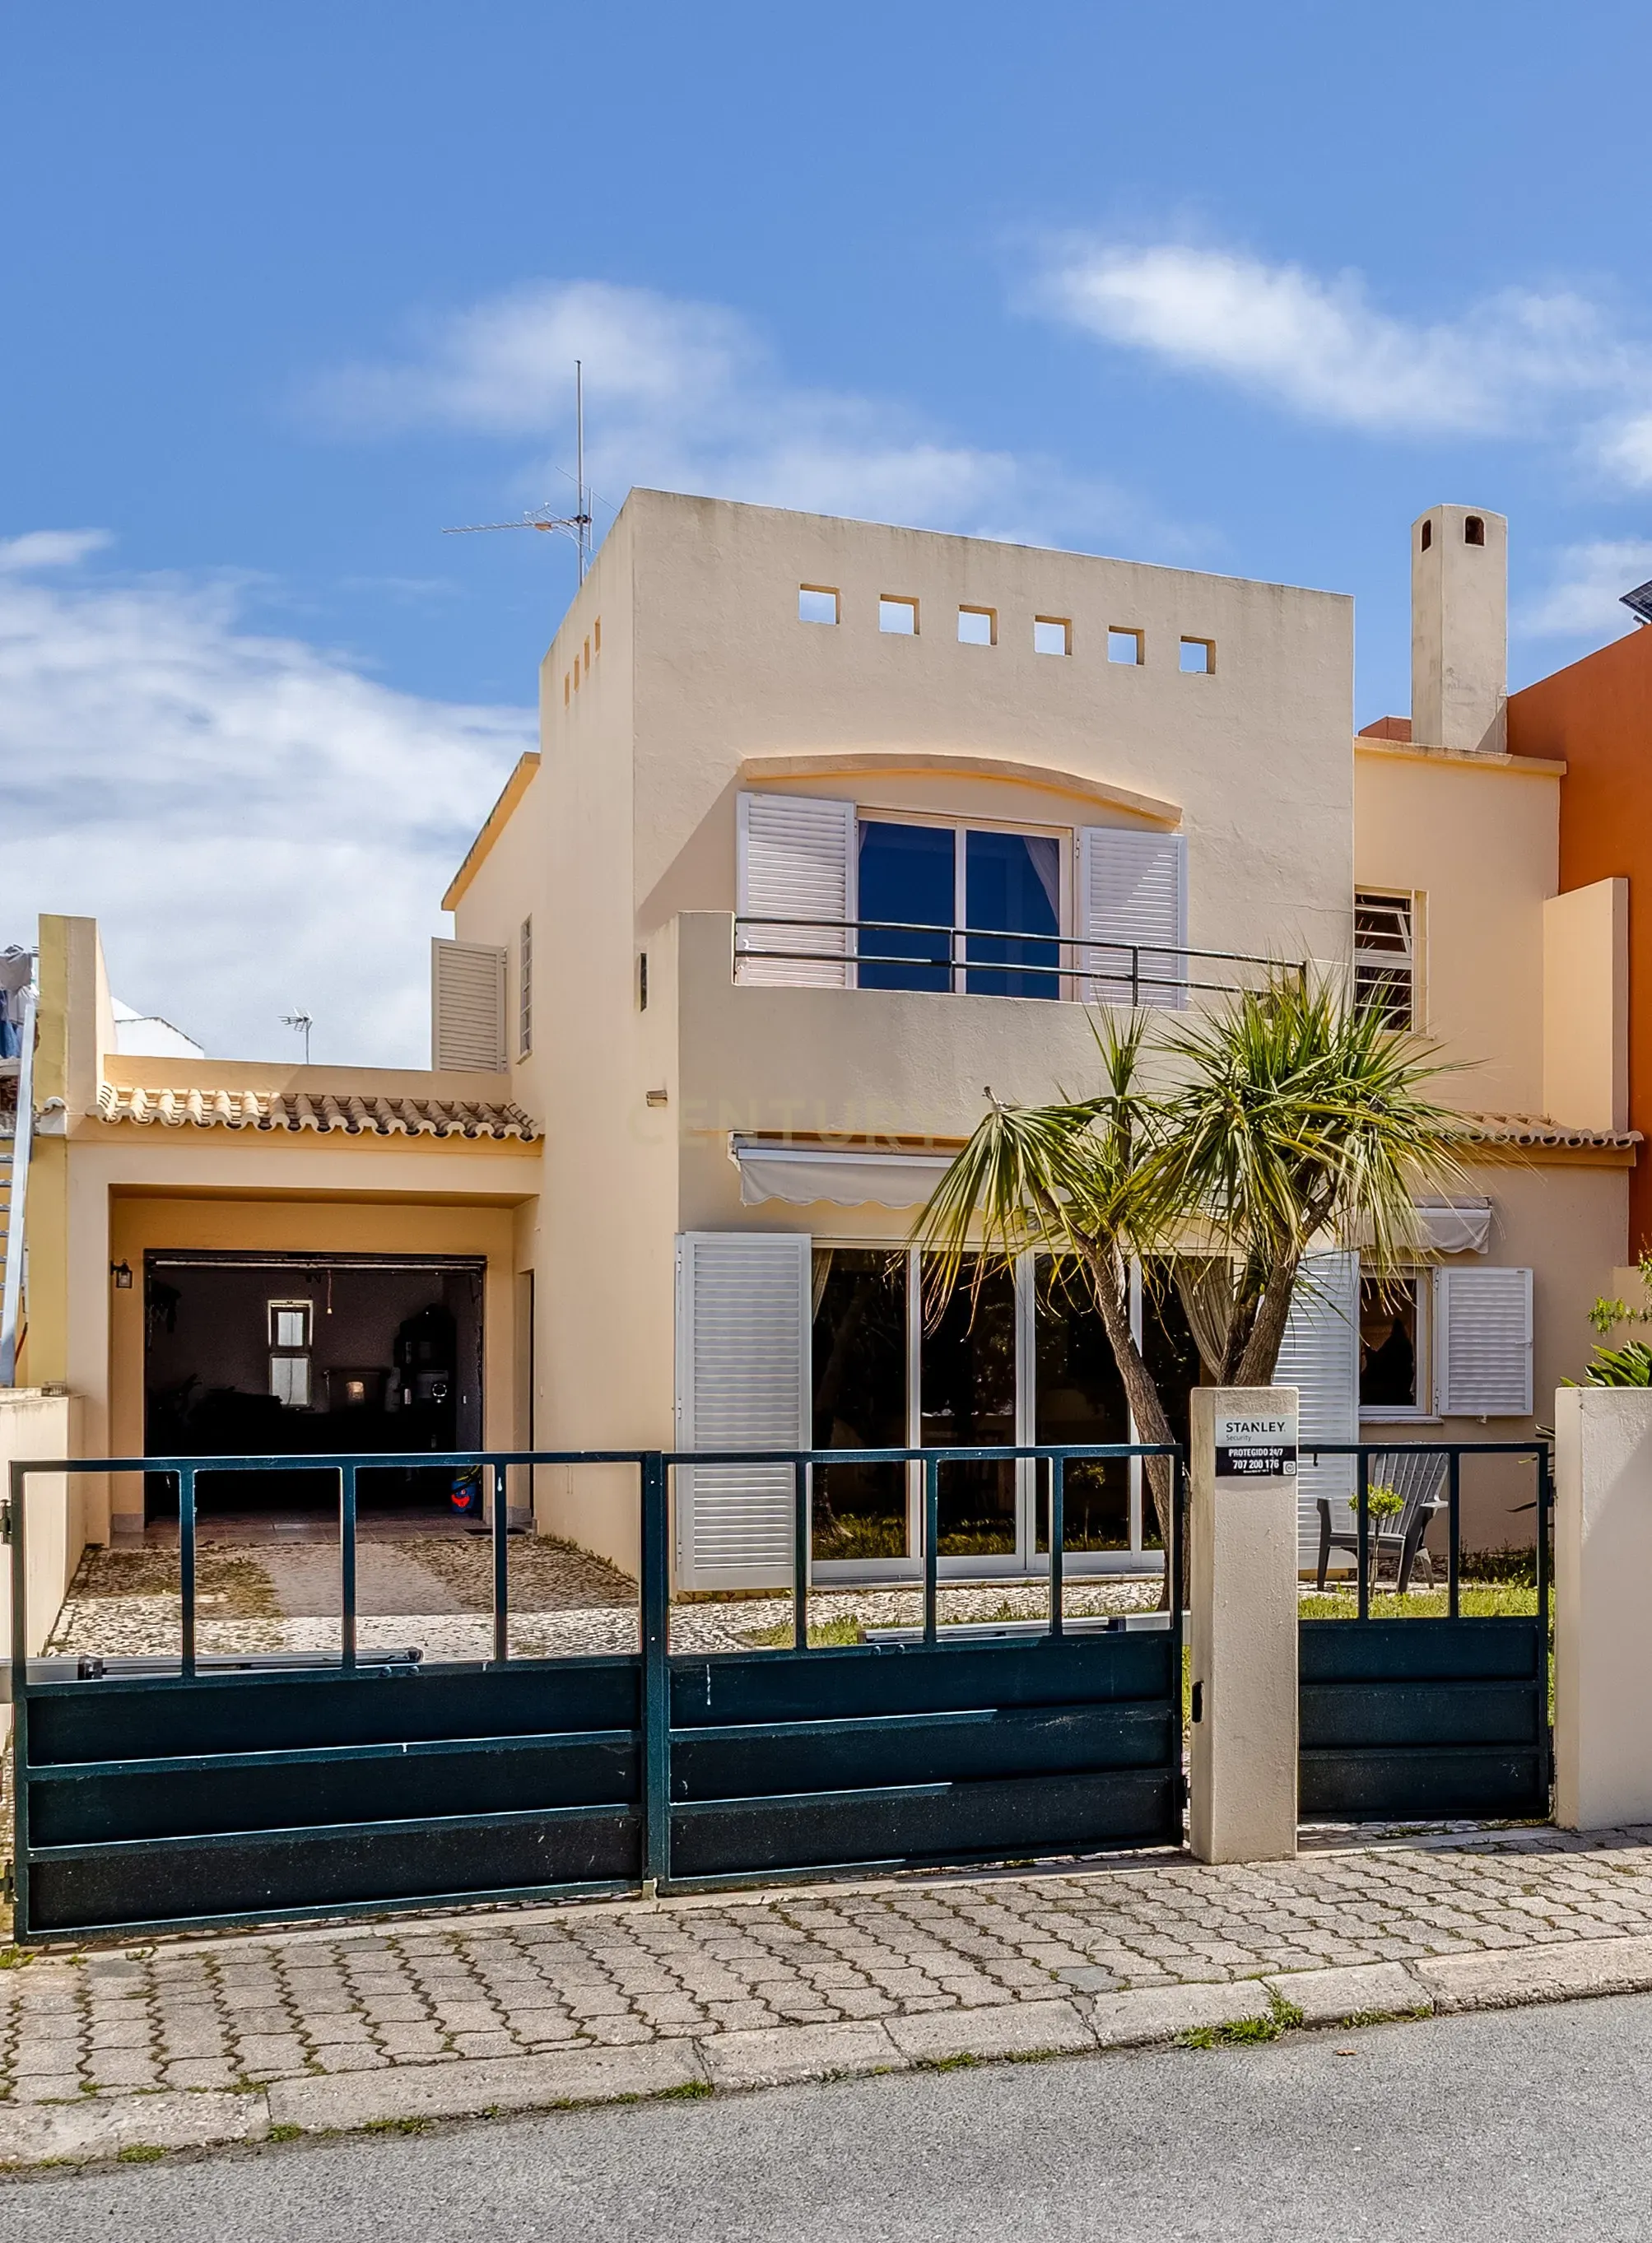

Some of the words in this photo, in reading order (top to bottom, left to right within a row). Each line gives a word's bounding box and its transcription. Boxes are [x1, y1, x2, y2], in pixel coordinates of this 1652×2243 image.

[1226, 1422, 1285, 1432] STANLEY
[1228, 1448, 1268, 1457] PROTEGIDO
[1268, 1448, 1283, 1456] 24/7
[1232, 1459, 1247, 1469] 707
[1249, 1459, 1263, 1469] 200
[1265, 1459, 1279, 1468] 176
